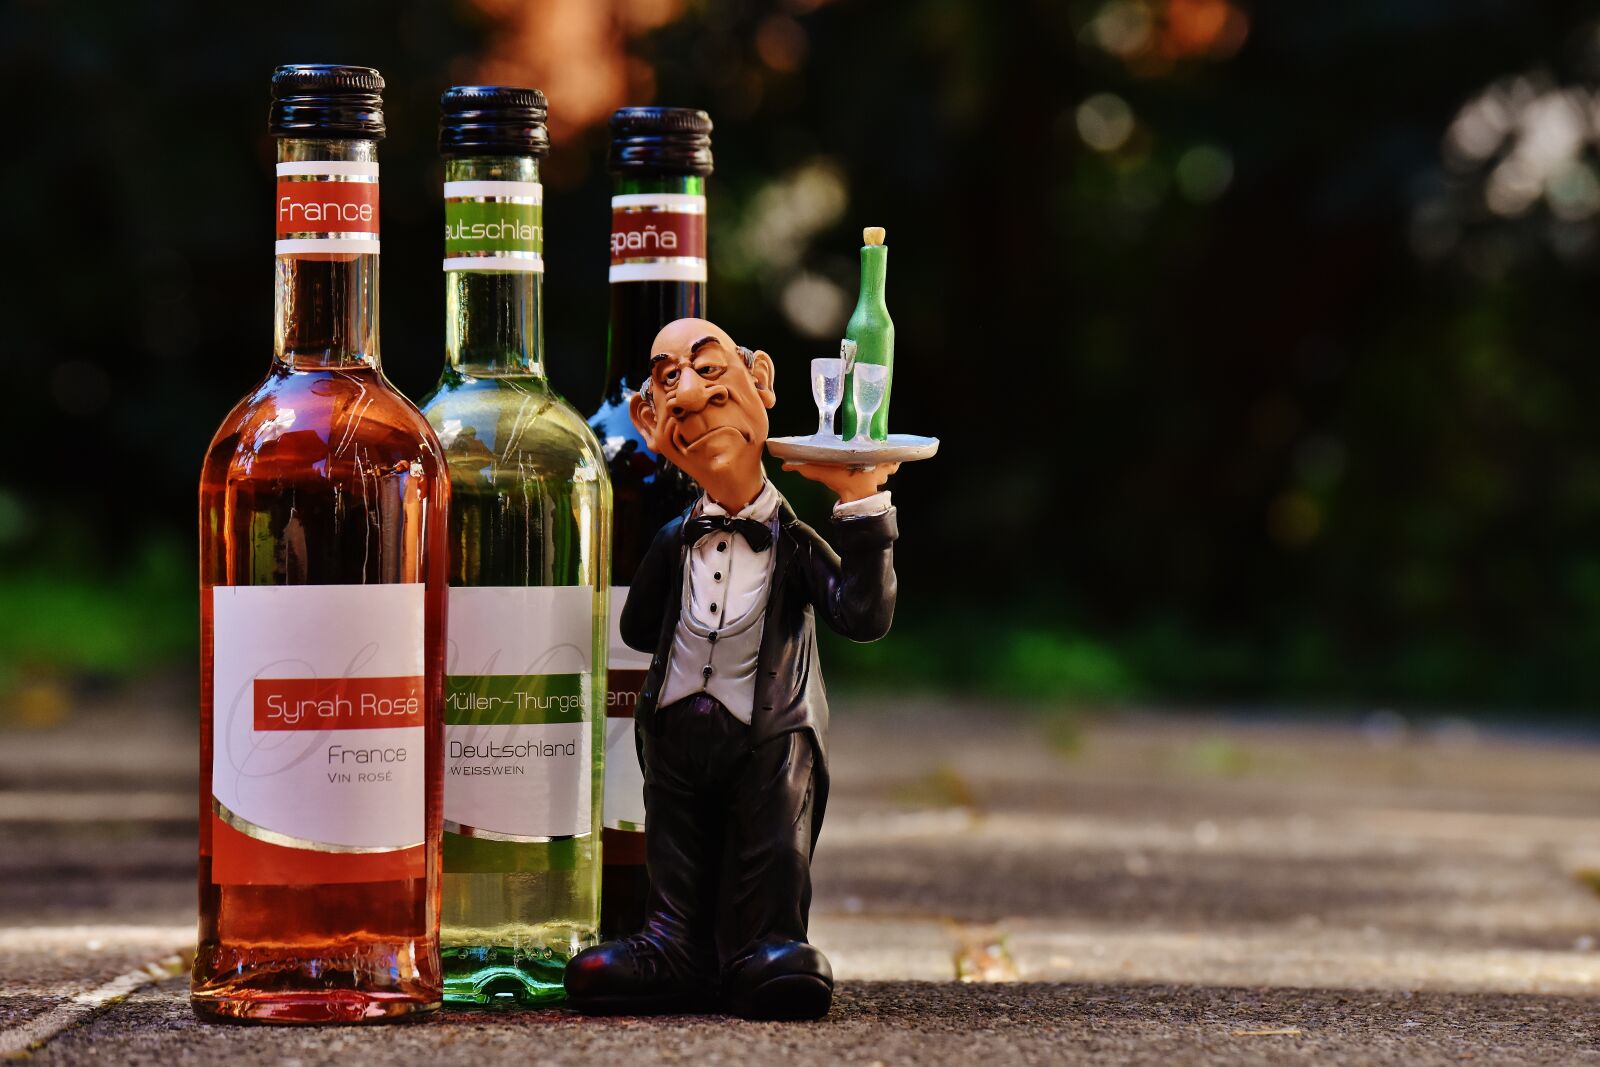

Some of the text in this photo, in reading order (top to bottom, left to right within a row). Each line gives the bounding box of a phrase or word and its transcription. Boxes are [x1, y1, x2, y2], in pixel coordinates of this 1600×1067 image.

[279, 196, 373, 222] France
[266, 688, 419, 724] Syrah Rosé
[328, 745, 407, 764] France
[450, 739, 576, 759] Deutschland
[327, 770, 393, 784] VIN ROSÉ
[450, 765, 525, 776] WEISSWEIN
